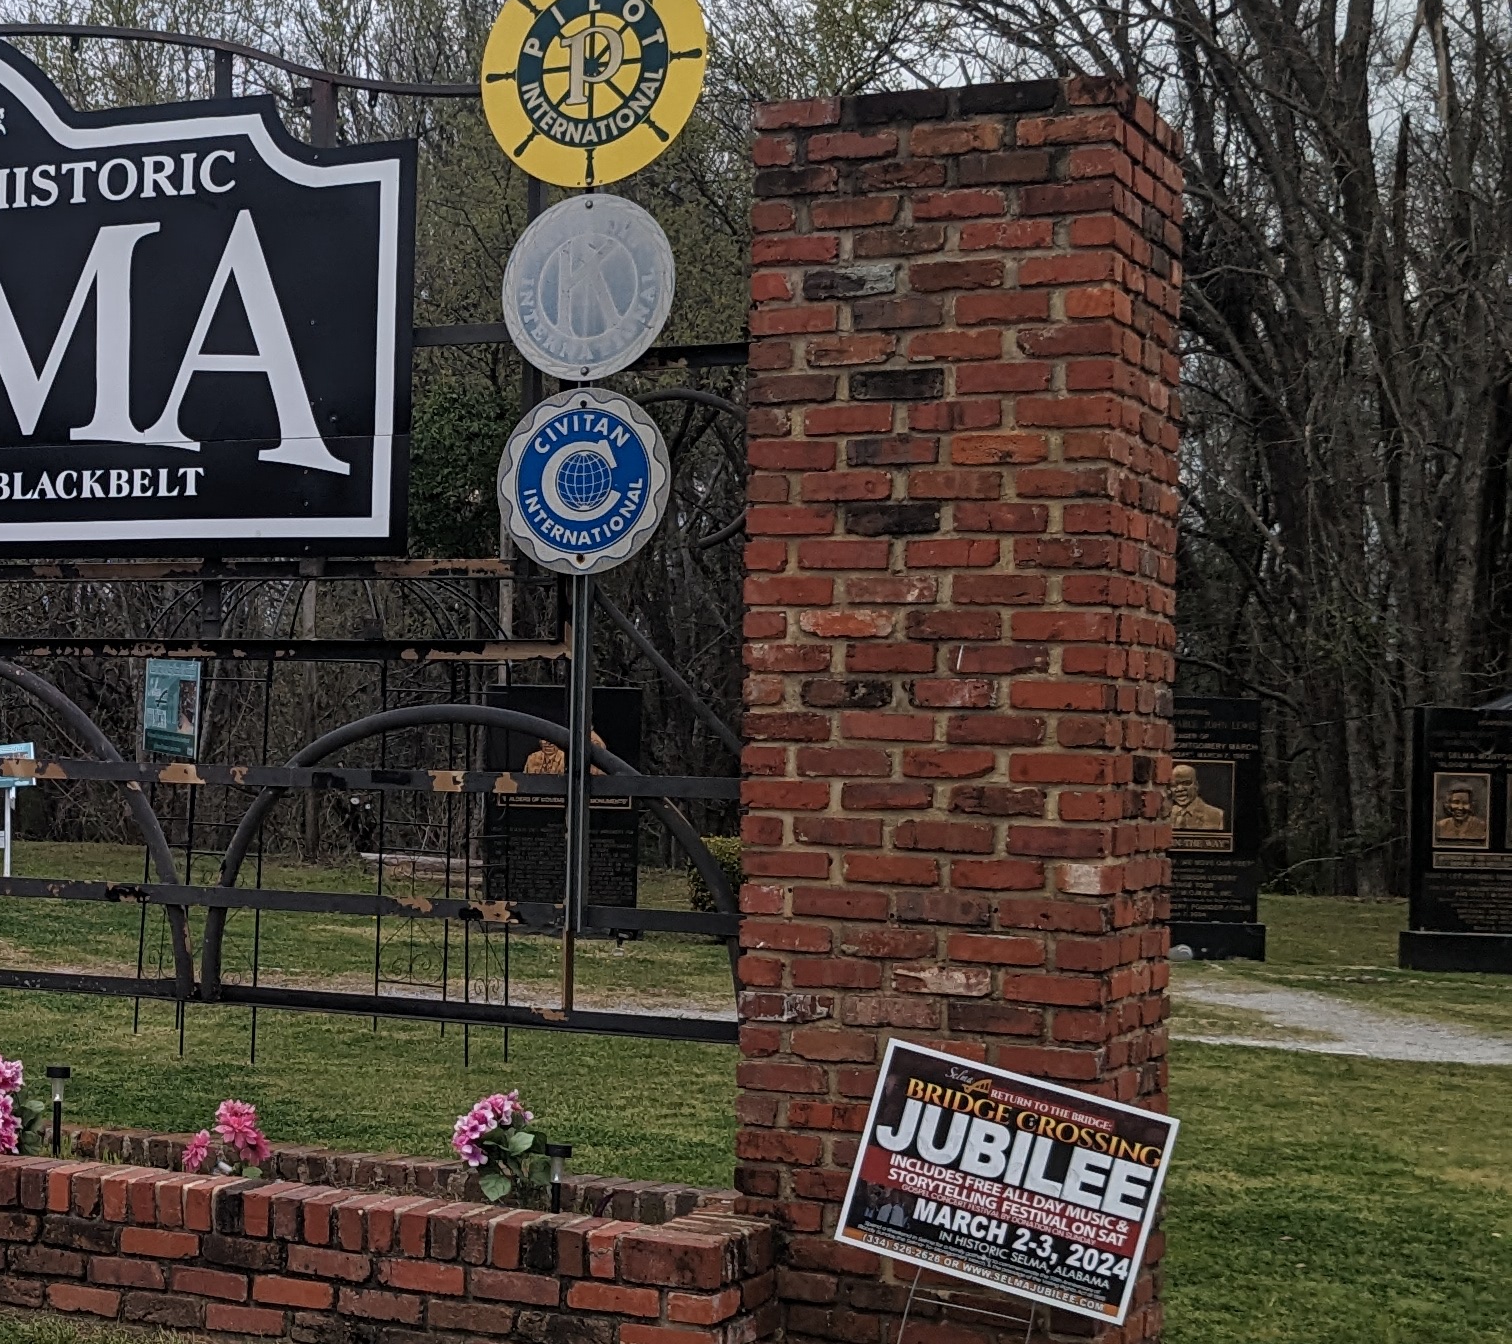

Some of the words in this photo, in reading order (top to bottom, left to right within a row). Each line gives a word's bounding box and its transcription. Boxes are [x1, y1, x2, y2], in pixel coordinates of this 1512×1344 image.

[521, 68, 664, 145] INTERNATIONAL
[534, 414, 631, 454] CIVITAN
[523, 478, 644, 546] INTERNATIONAL
[907, 1079, 1012, 1124] BRIDGE
[1017, 1112, 1161, 1166] CROSSING
[991, 1089, 1032, 1107] RETURN
[1034, 1101, 1049, 1112] TO
[1051, 1106, 1070, 1118] THE
[877, 1100, 1151, 1219] JUBILEE
[890, 1154, 963, 1184] INCLUDES
[965, 1176, 1002, 1196] FREE
[1002, 1187, 1030, 1205] ALL
[1033, 1195, 1065, 1213] DAY
[1065, 1205, 1116, 1229] MUSIC
[1116, 1220, 1129, 1233] &
[902, 1184, 929, 1197] GOSPEL
[888, 1168, 997, 1209] STORYTELLING
[1002, 1201, 1069, 1231] FESTIVAL
[1072, 1222, 1096, 1238] ON
[1097, 1229, 1127, 1246] SAT
[913, 1198, 1007, 1244] MARCH
[1012, 1228, 1058, 1264] 2-3,
[1066, 1244, 1129, 1280] 2024
[939, 1231, 953, 1242] IN
[955, 1235, 1008, 1259] HISTORIC
[1010, 1252, 1053, 1273] SELMA,
[1053, 1266, 1109, 1289] ALABAMA
[944, 1258, 959, 1268] OR
